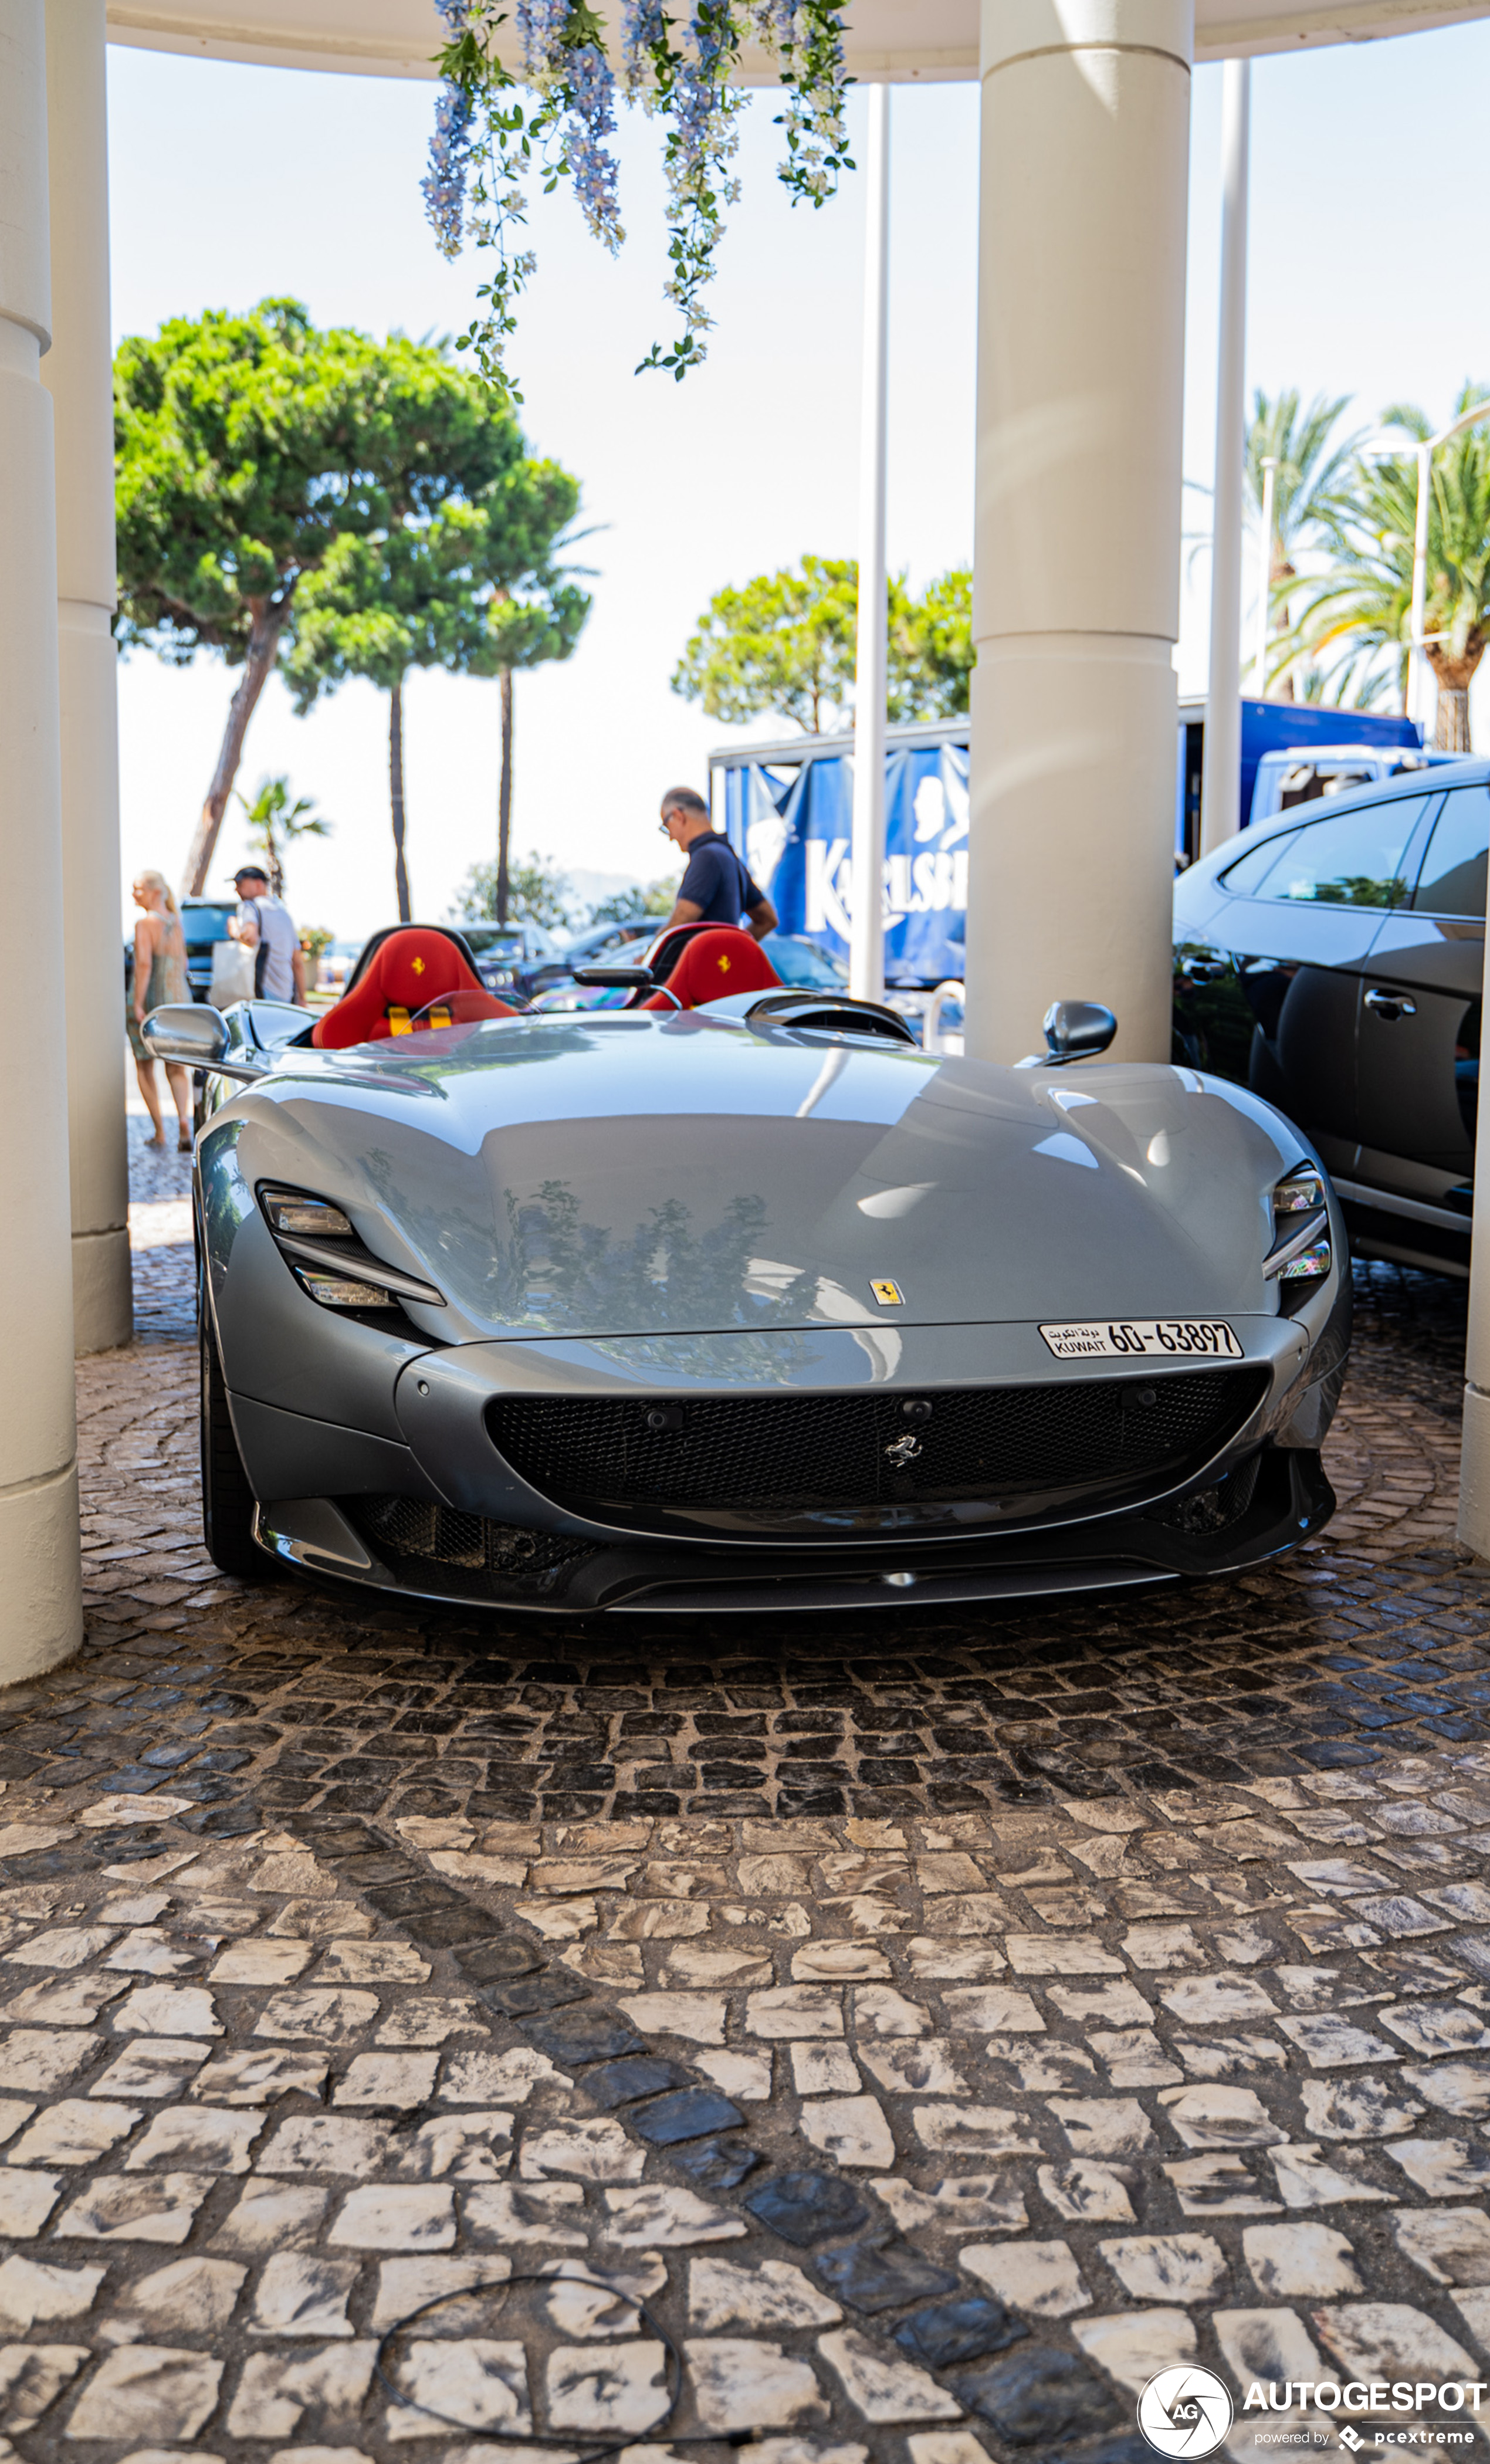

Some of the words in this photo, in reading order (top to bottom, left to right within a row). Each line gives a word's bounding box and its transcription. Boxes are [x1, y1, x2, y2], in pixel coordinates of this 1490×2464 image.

[805, 838, 968, 942] KLSB
[1048, 1329, 1079, 1341] الكويت
[1078, 1328, 1099, 1338] دولة
[1055, 1341, 1106, 1353] KUWAIT
